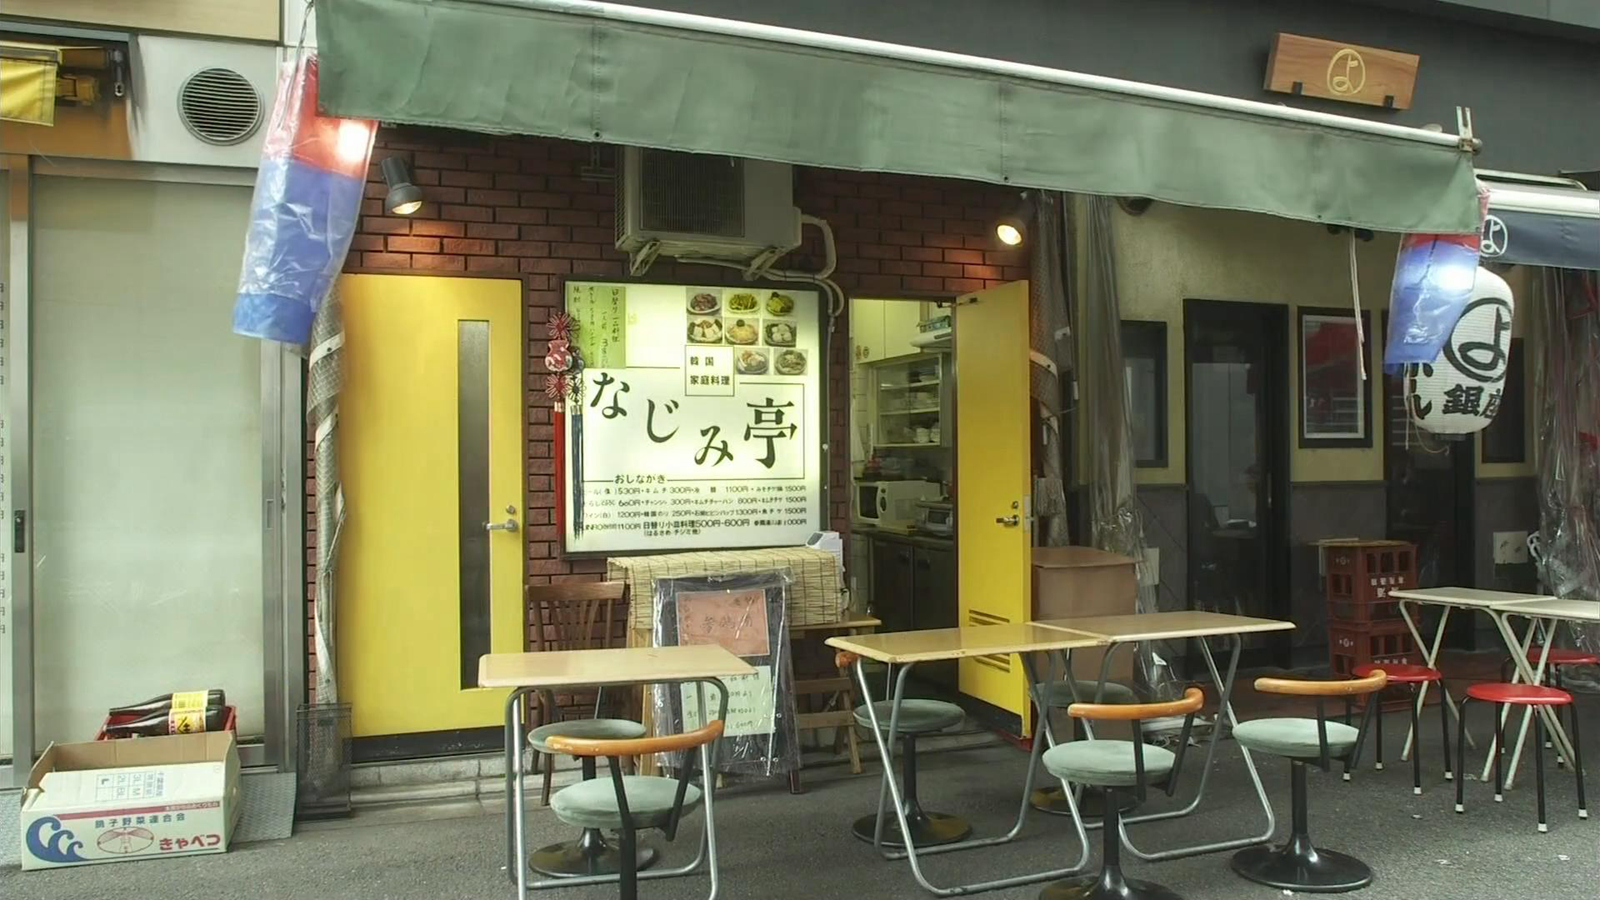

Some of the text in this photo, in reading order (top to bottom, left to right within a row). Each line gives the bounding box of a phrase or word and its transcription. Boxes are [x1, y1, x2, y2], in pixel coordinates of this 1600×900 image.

[690, 375, 730, 386] 家庭料理
[589, 372, 798, 469] なじみ亭
[614, 474, 667, 485] おしながき
[159, 834, 221, 851] きゃべつ
